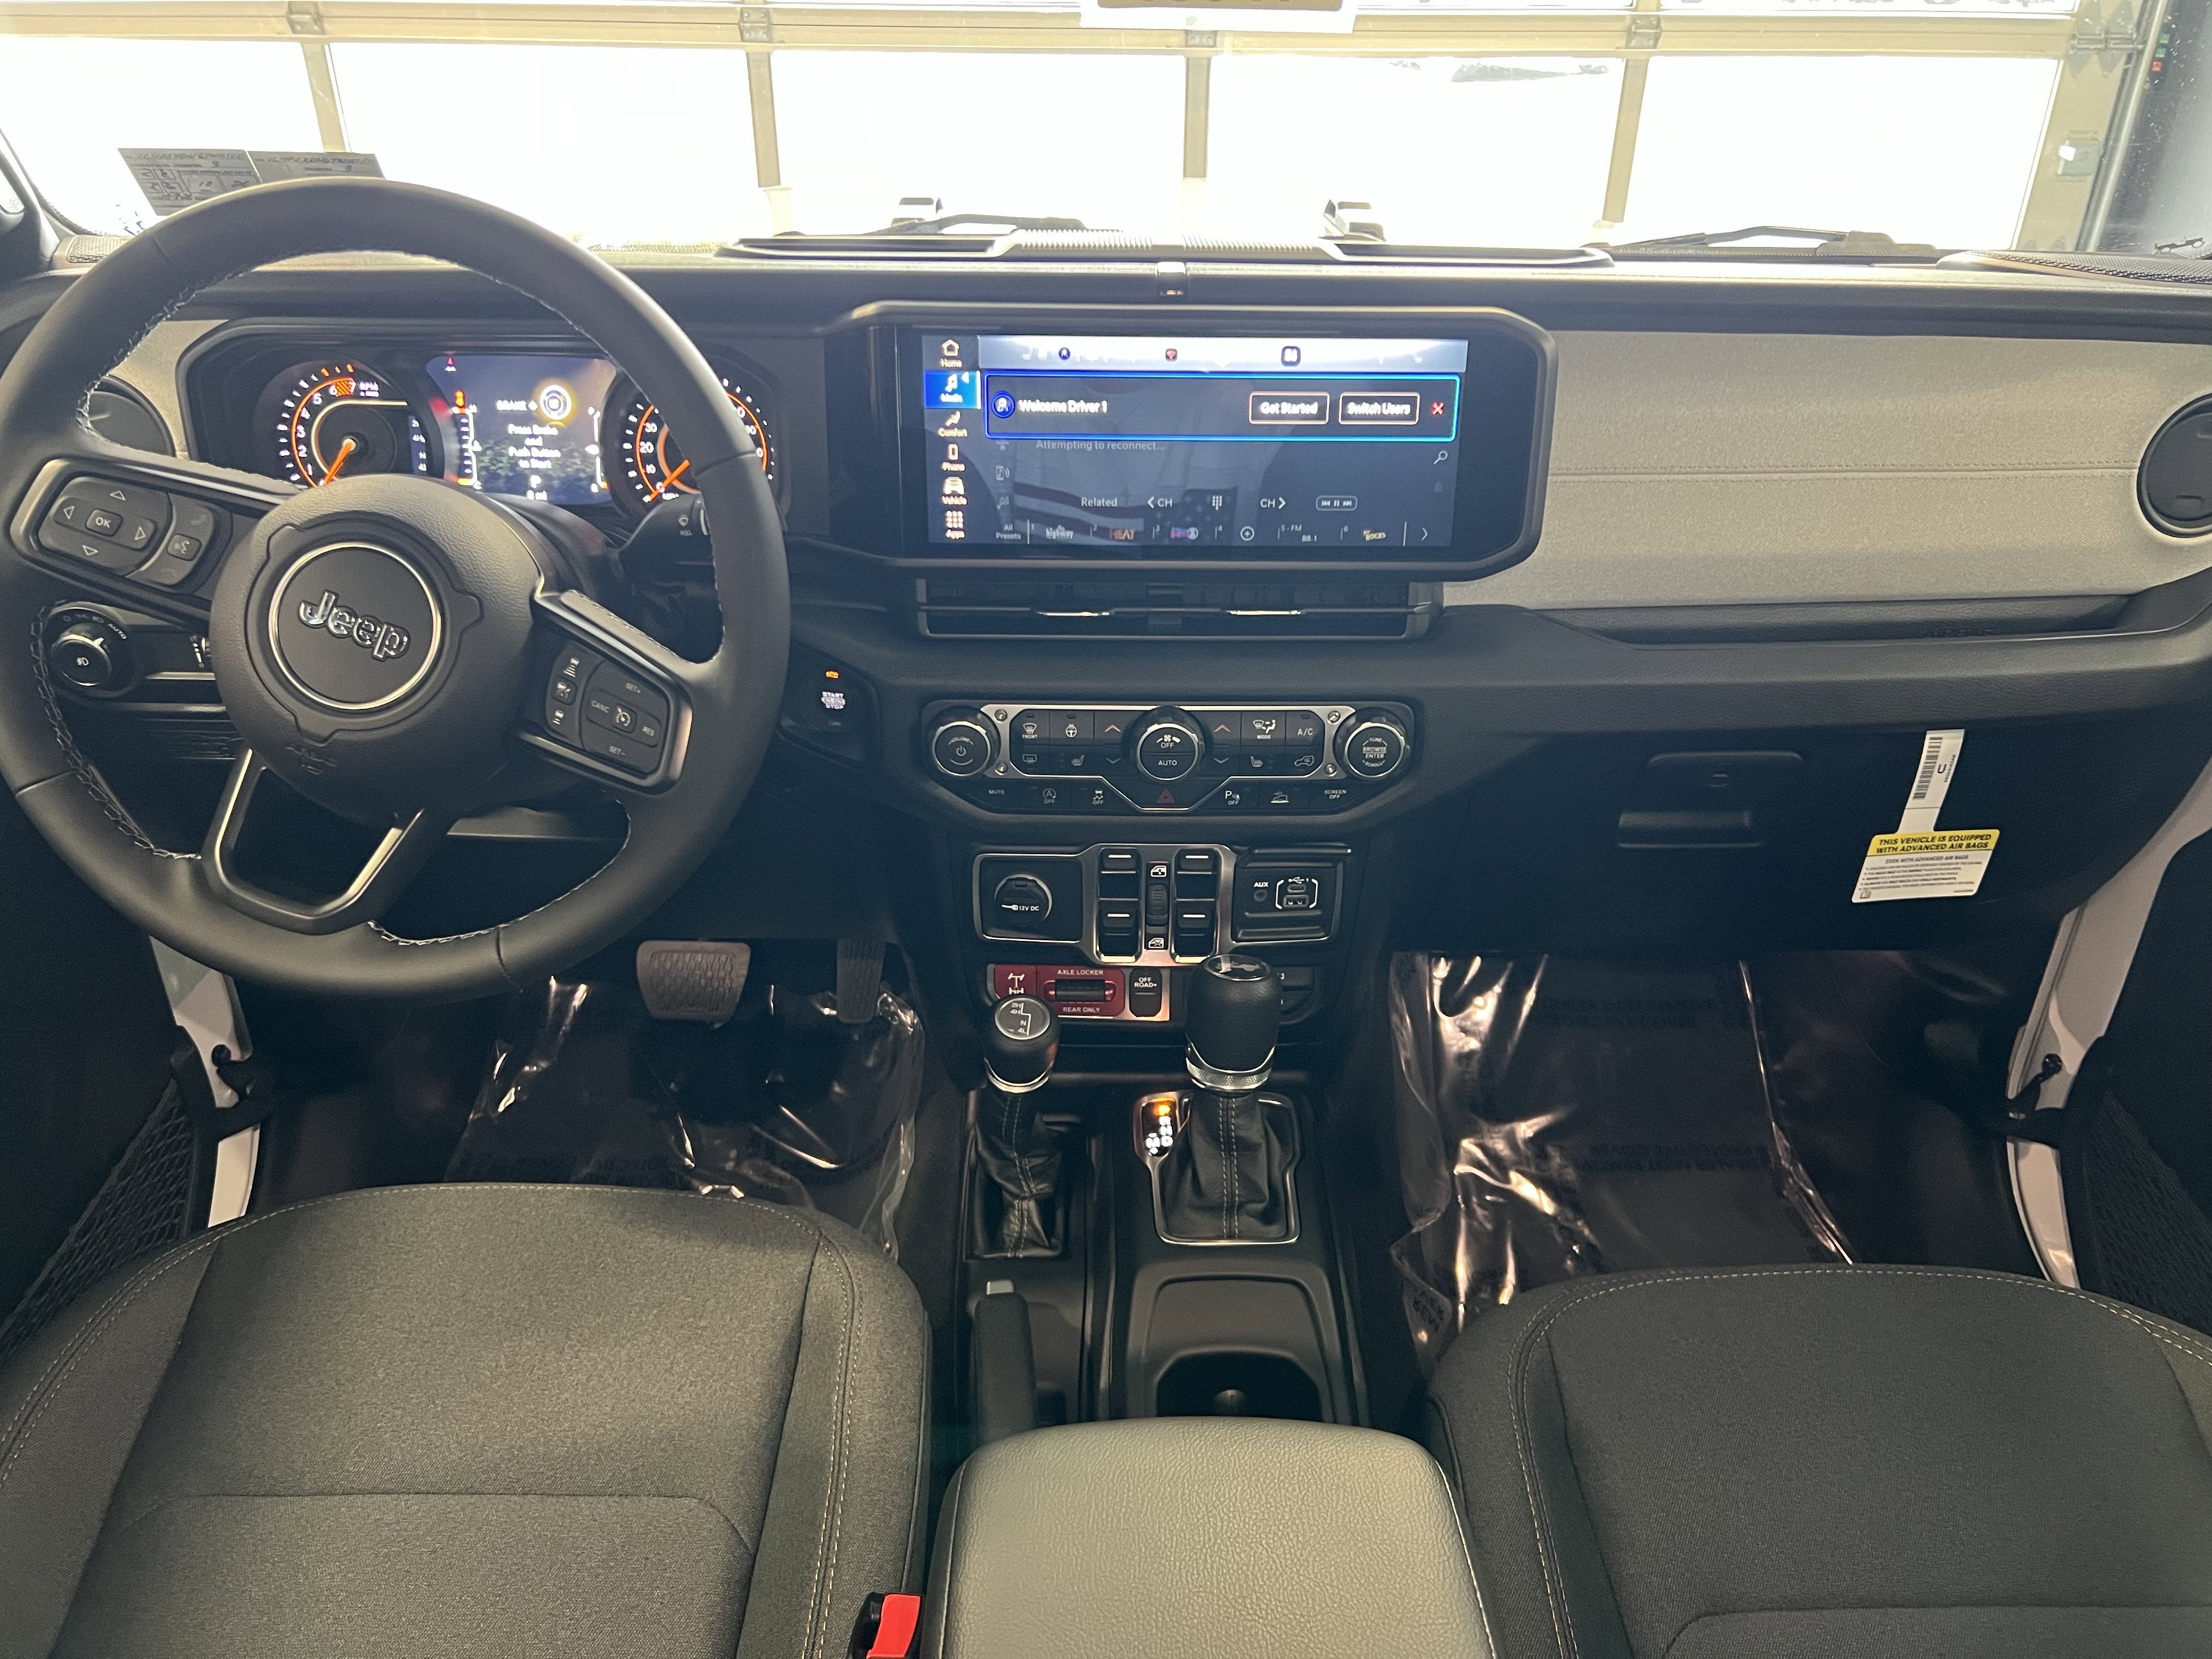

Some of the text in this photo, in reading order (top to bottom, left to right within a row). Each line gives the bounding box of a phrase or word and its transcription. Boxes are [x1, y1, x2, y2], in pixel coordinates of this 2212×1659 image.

[940, 358, 962, 368] Home
[329, 385, 337, 396] 6
[313, 392, 322, 404] 5
[1019, 399, 1108, 413] Welcome Driver 1
[1261, 402, 1318, 415] Get Started
[1347, 402, 1411, 415] Switch Users
[301, 407, 310, 419] 4
[297, 425, 306, 438] 3
[645, 422, 657, 433] 30
[938, 428, 967, 437] Comfort
[297, 445, 307, 457] 2
[639, 441, 654, 454] 20
[1036, 441, 1092, 452] Attempting
[1095, 441, 1104, 450] to
[646, 464, 656, 474] 10
[941, 462, 965, 471] Phone
[1081, 498, 1118, 507] Related
[1158, 498, 1172, 507] CH
[1261, 499, 1275, 508] CH
[96, 517, 111, 528] OK
[945, 529, 965, 539] Apps
[1046, 527, 1074, 539] highway
[1109, 528, 1136, 540] HEAT
[299, 591, 409, 659] Jeep
[108, 623, 127, 639] AUTO
[591, 701, 610, 713] CANC
[642, 726, 655, 736] RES
[1297, 727, 1313, 736] A/C
[1938, 764, 1947, 774] U
[1899, 844, 1947, 852] ADVANCED
